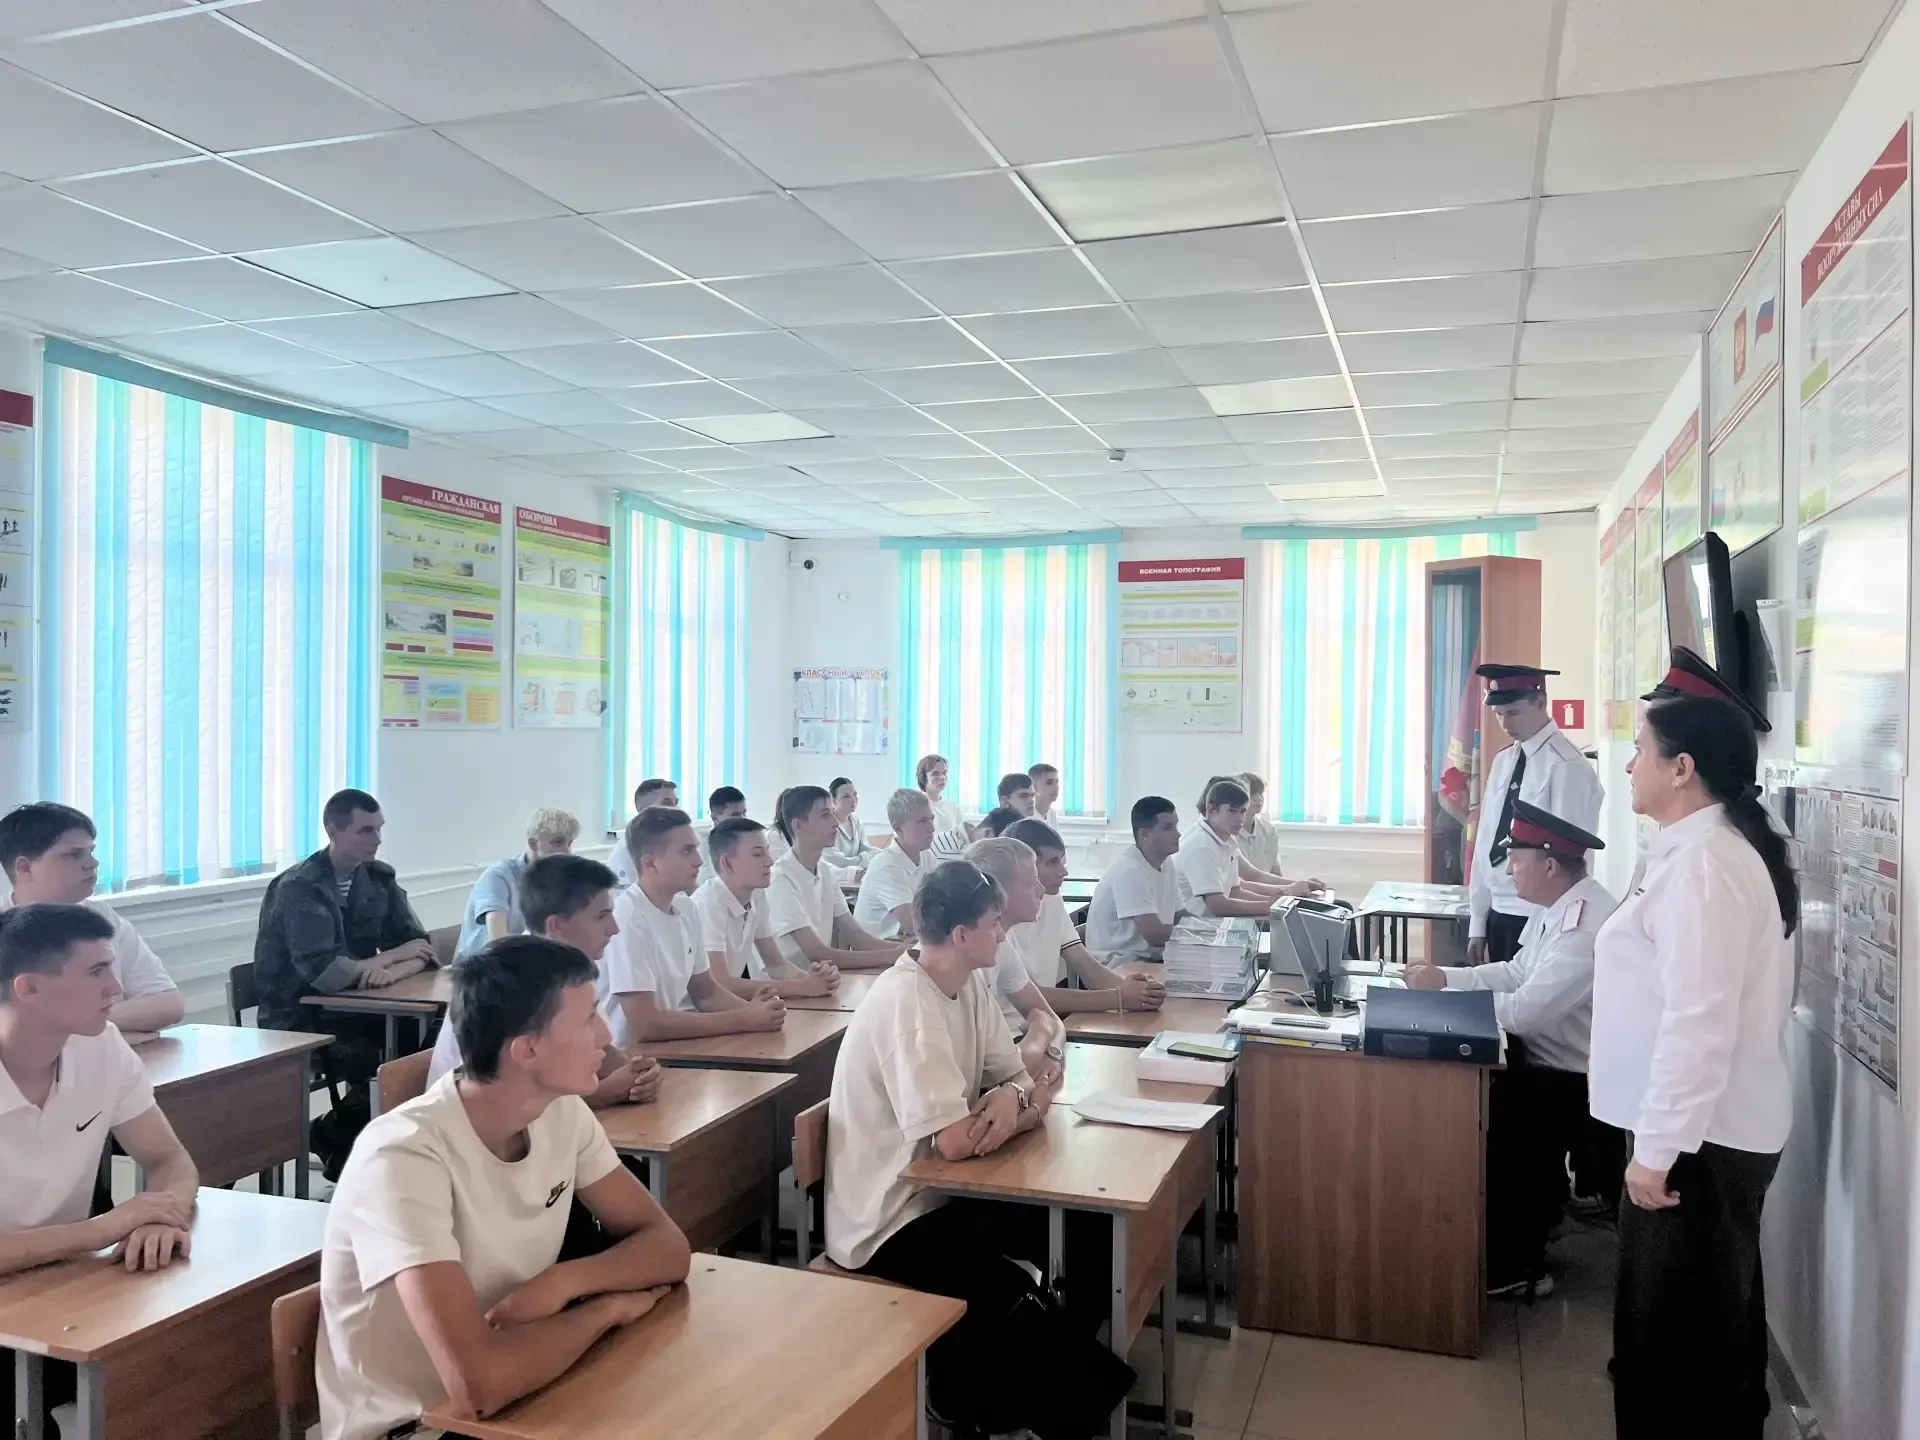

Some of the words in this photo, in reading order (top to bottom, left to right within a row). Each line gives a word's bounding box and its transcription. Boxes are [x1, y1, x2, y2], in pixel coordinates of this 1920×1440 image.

[1833, 189, 1861, 239] УСТАВЫ
[1817, 204, 1867, 281] ВООРУЖЕННЫХ
[1867, 186, 1883, 218] СИЛ
[431, 489, 500, 514] ГРАЖДАНСКАЯ
[518, 509, 558, 527] ОБОРОНА
[1139, 567, 1172, 575] ВОЕННАЯ
[1173, 566, 1221, 574] ТОПОГРАФИЯ
